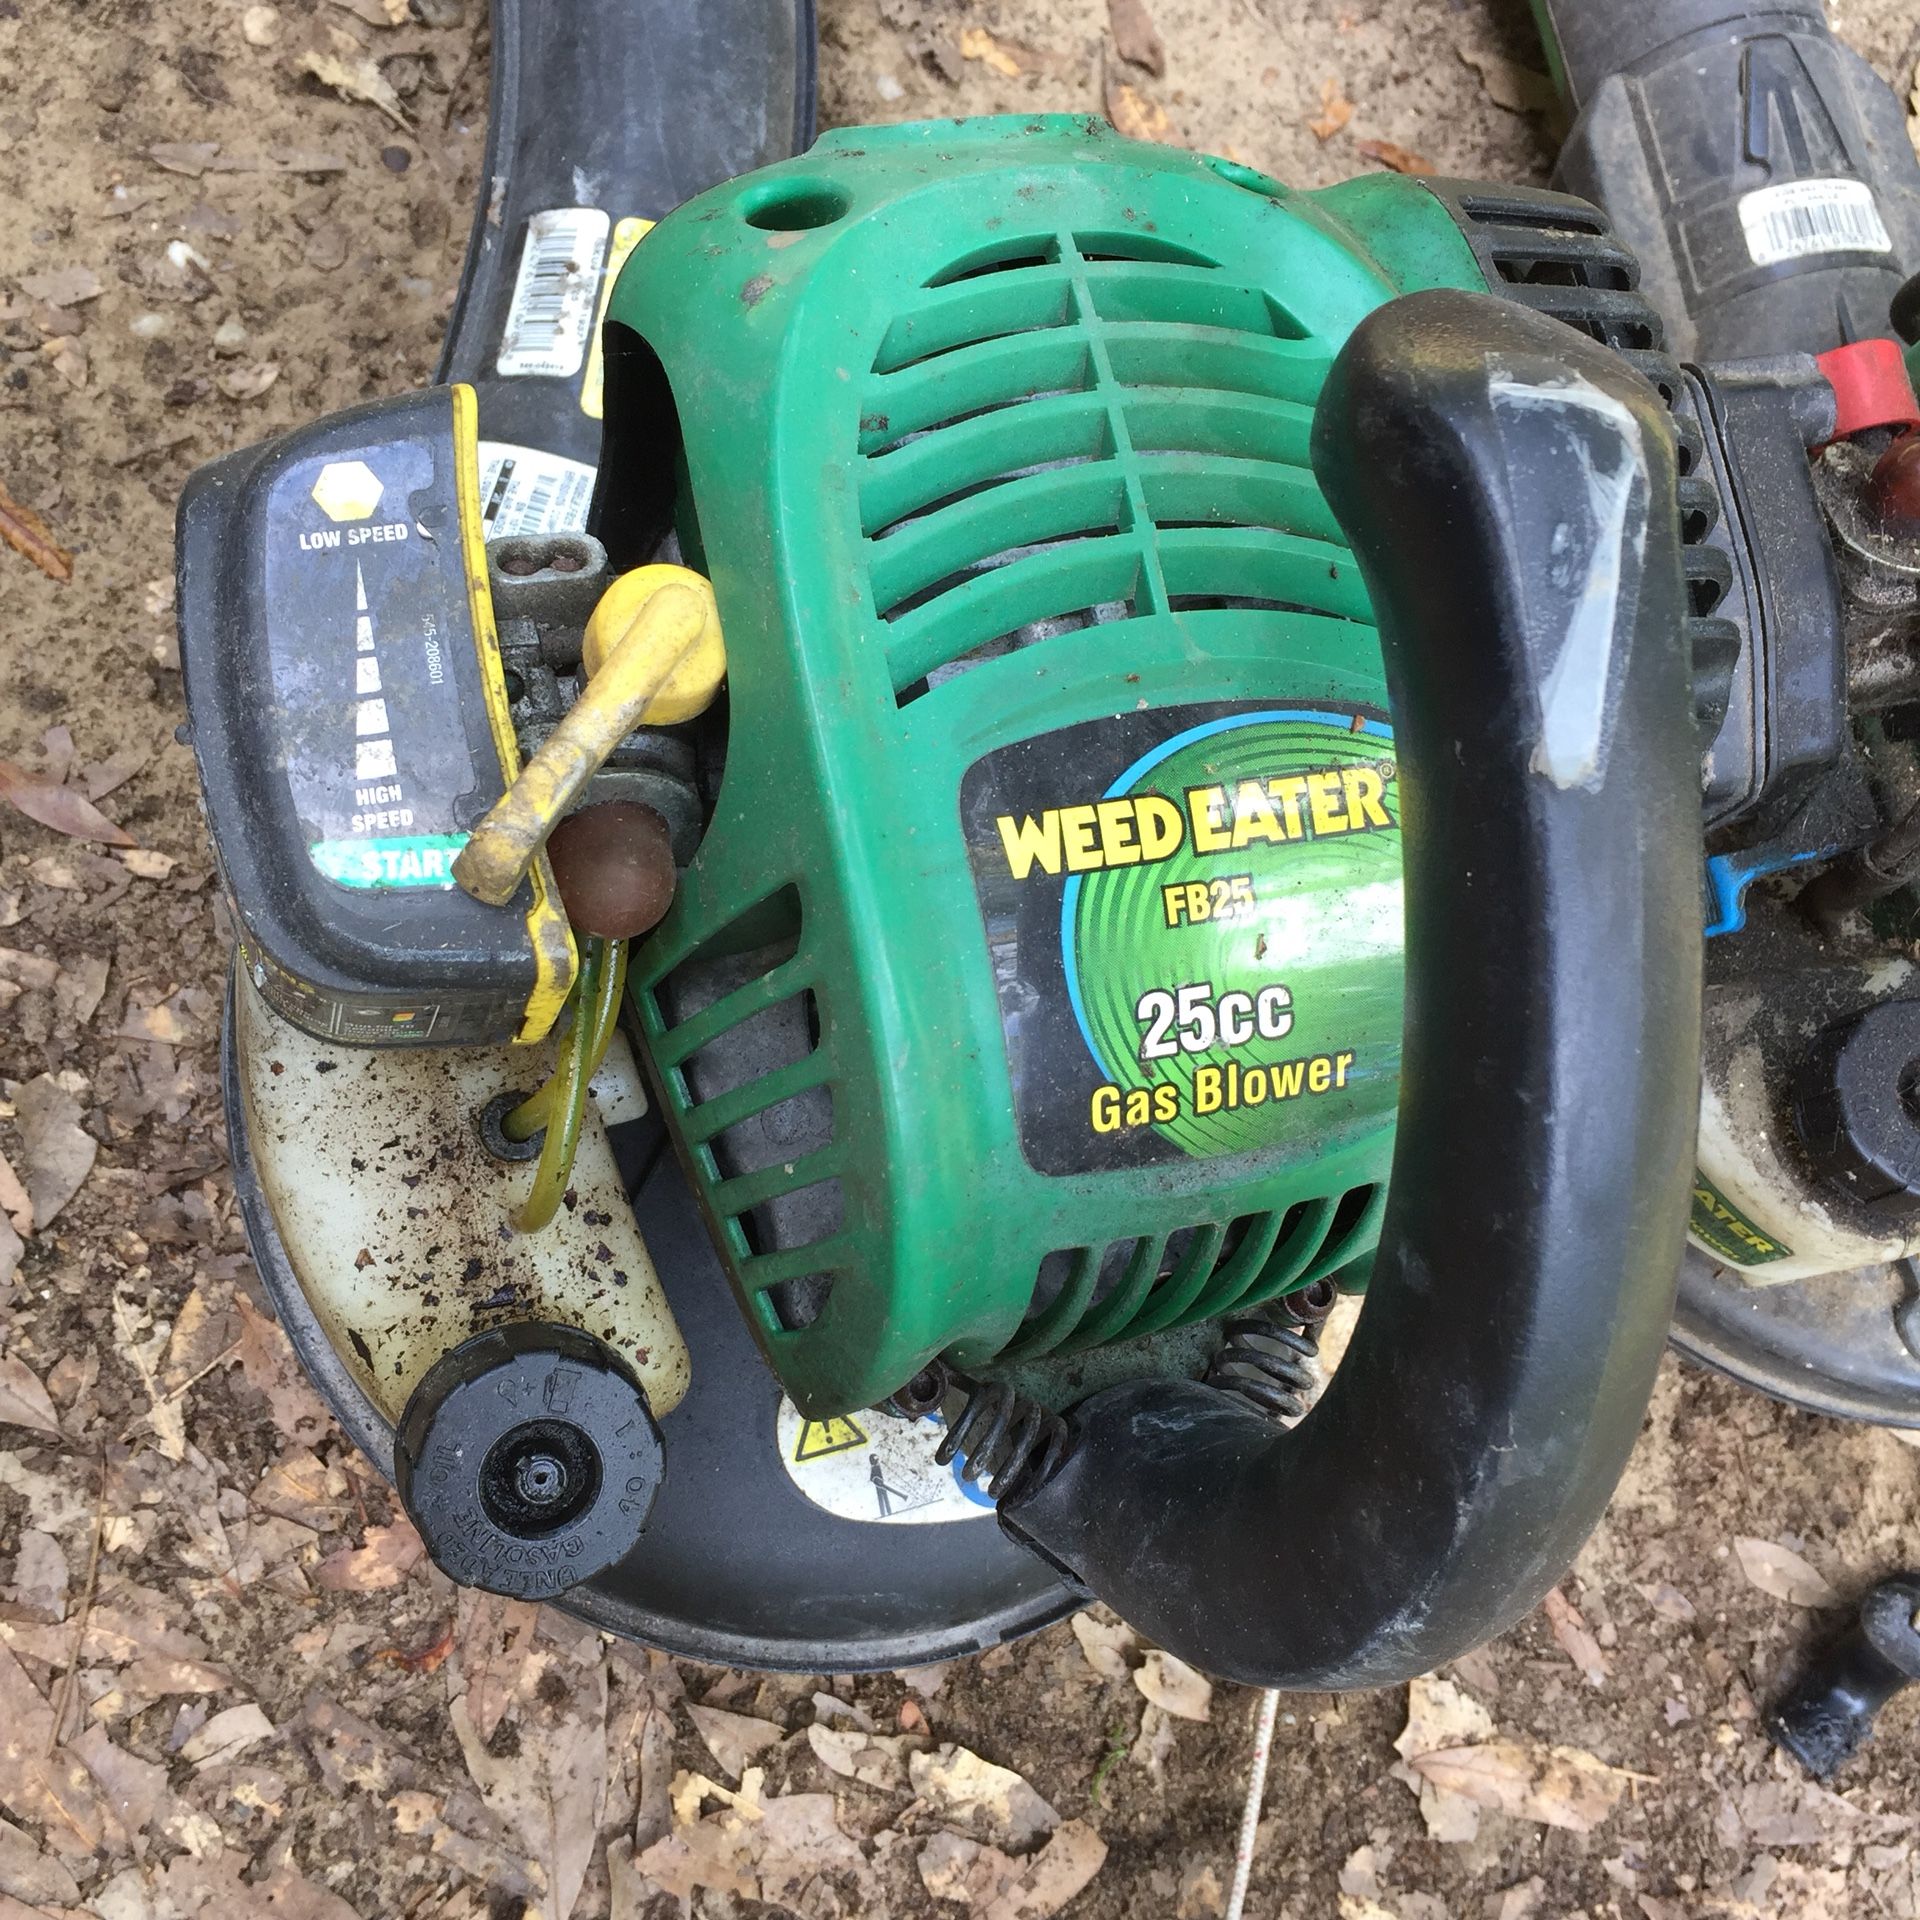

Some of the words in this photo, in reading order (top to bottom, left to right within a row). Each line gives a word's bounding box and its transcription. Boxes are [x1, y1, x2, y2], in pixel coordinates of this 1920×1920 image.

[300, 530, 341, 551] LOW
[348, 523, 409, 546] SPEED
[421, 613, 444, 686] 545-208601
[351, 808, 414, 833] SPEED
[355, 784, 403, 807] HIGH
[996, 796, 1184, 880] WEED
[1164, 876, 1255, 927] FB25
[1137, 984, 1292, 1060] 25cc
[1091, 1084, 1178, 1133] Gas
[1195, 1053, 1353, 1114] Blower
[1693, 1189, 1775, 1253] ATER
[437, 1531, 578, 1590] UNLEADED
[453, 1507, 584, 1565] GASOLINE
